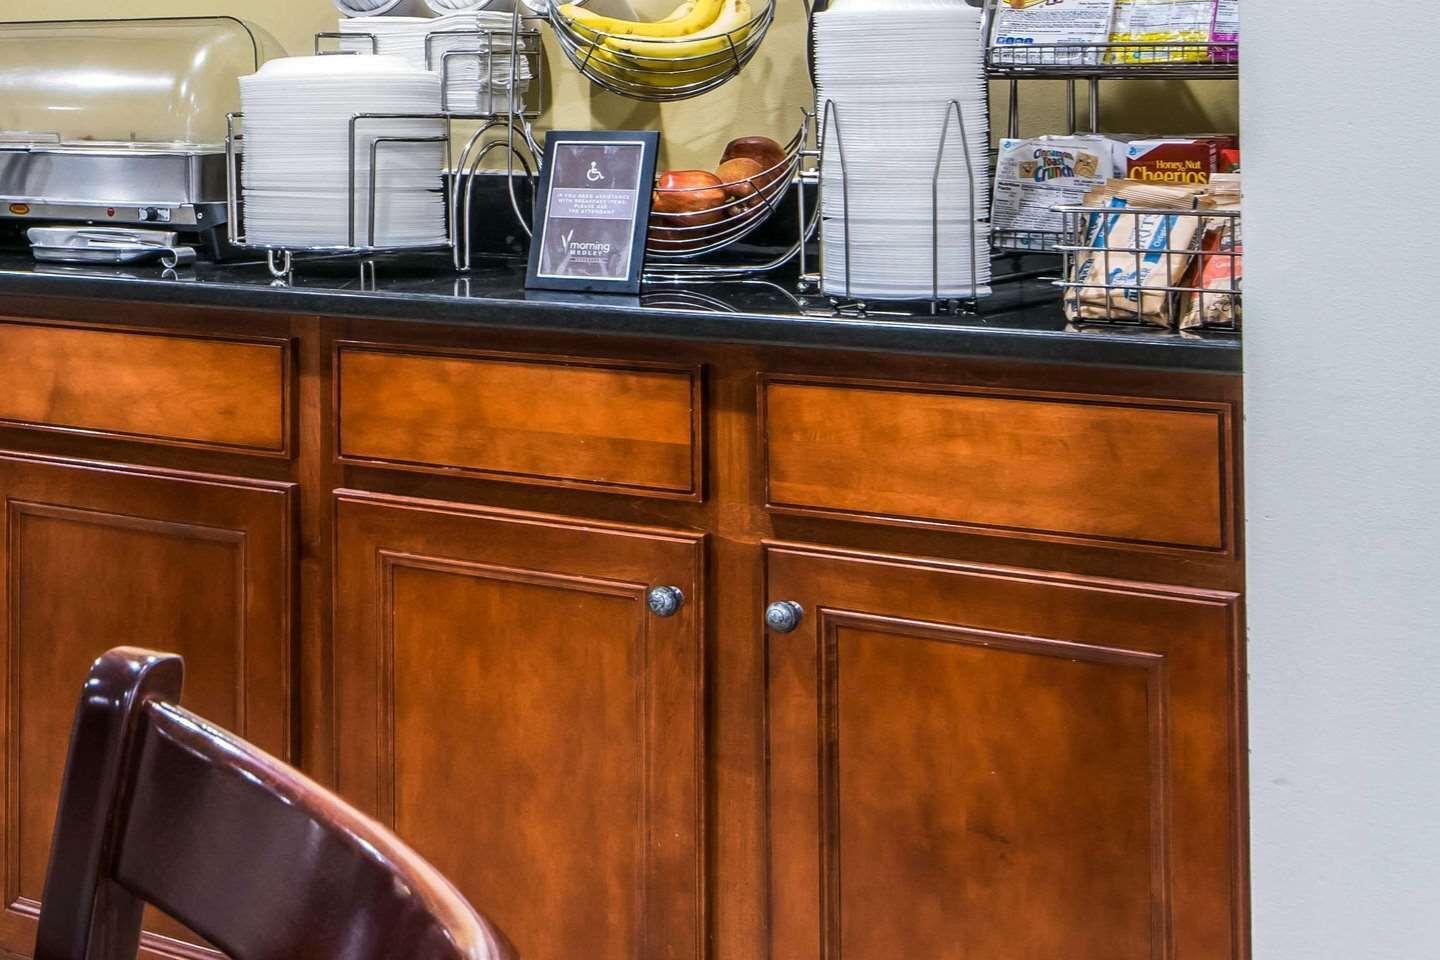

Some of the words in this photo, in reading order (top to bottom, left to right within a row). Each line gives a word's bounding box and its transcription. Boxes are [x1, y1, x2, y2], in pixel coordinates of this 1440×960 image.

[1156, 160, 1182, 172] Honey
[1185, 160, 1201, 170] Nut
[1130, 166, 1208, 185] Cheerios
[570, 241, 610, 253] morning
